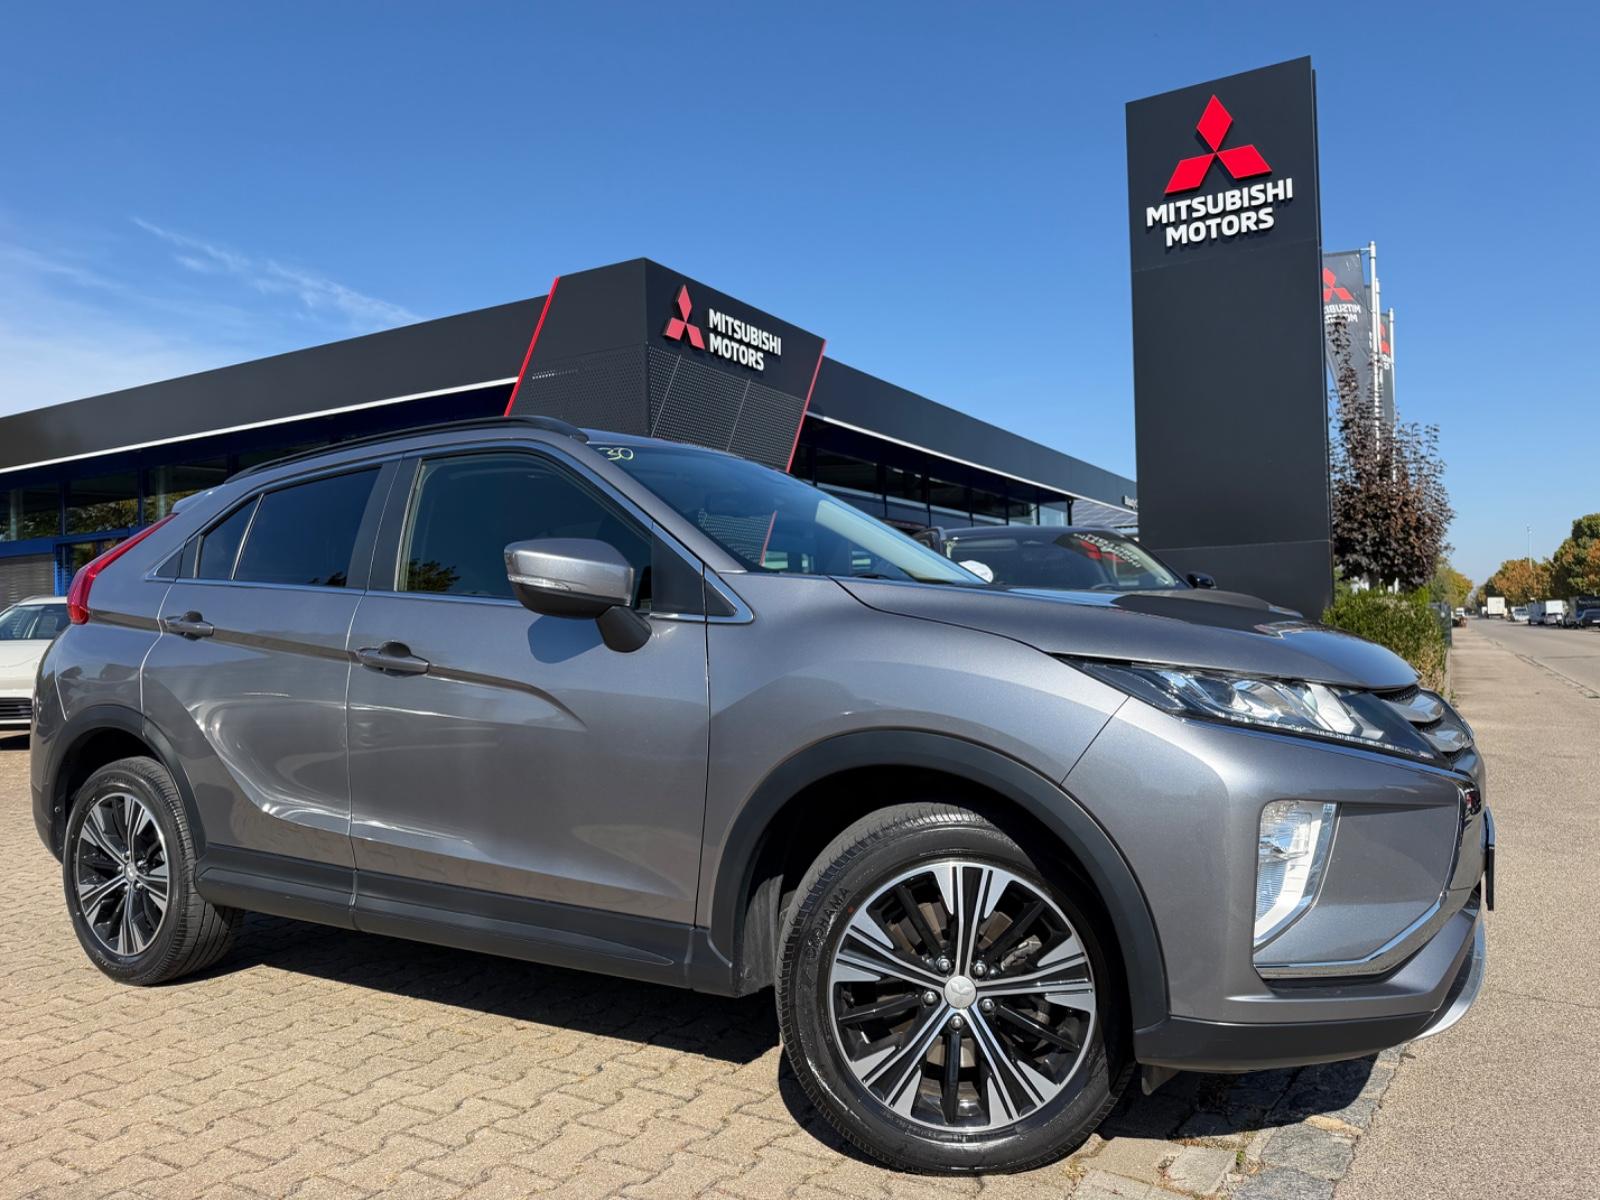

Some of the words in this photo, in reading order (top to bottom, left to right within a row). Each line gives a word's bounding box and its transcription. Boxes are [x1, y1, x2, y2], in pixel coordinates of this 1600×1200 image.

[1146, 178, 1293, 227] MITSUBISHI
[1166, 207, 1275, 247] MOTORS
[709, 308, 782, 356] MITSUBISHI
[709, 333, 764, 371] MOTORS
